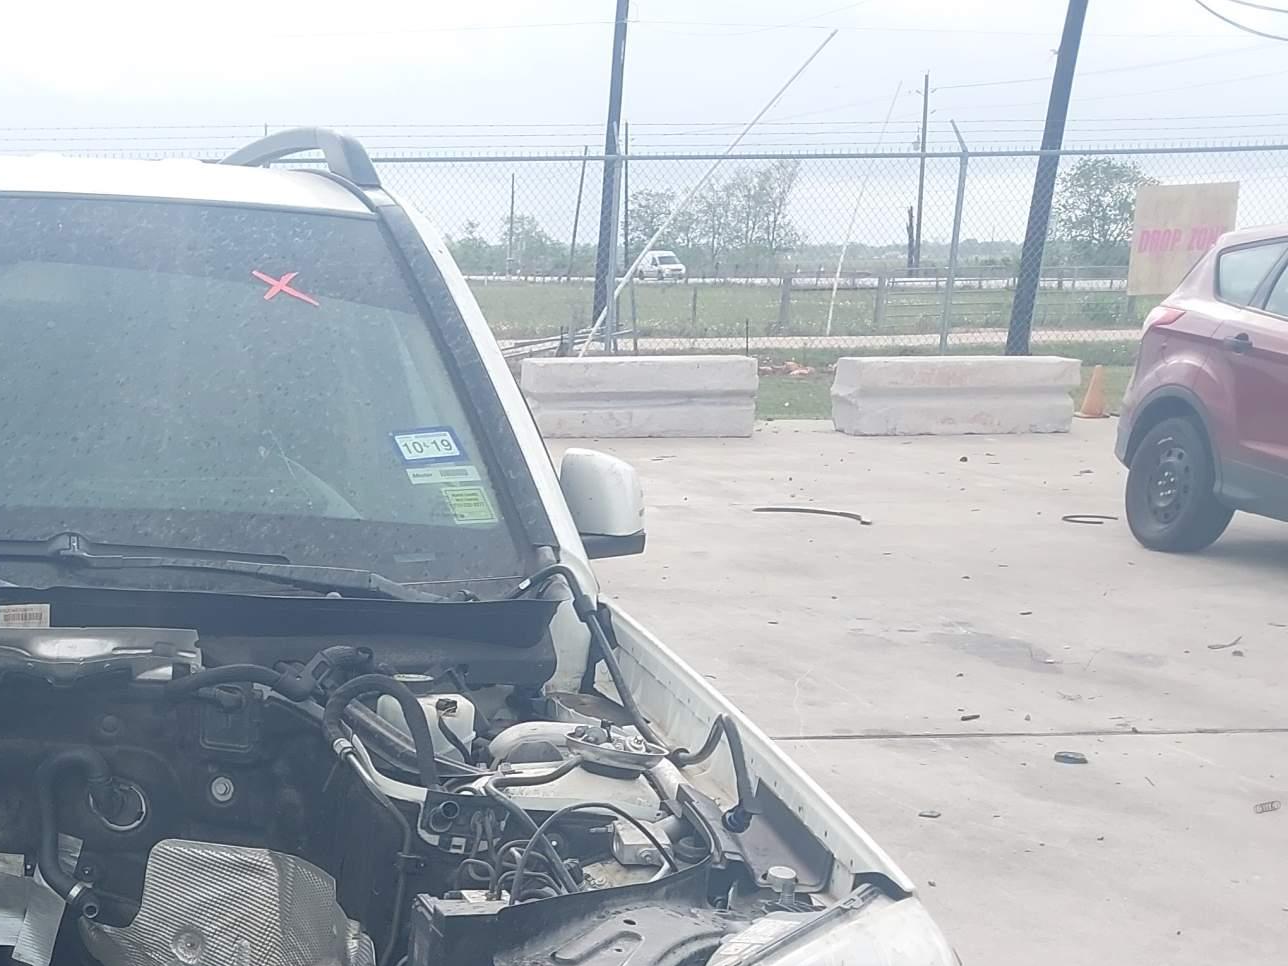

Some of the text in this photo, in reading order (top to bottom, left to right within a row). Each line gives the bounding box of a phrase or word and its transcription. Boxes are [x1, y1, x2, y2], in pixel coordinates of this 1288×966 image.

[1138, 225, 1227, 253] DROP ZON
[402, 438, 453, 455] 10 19
